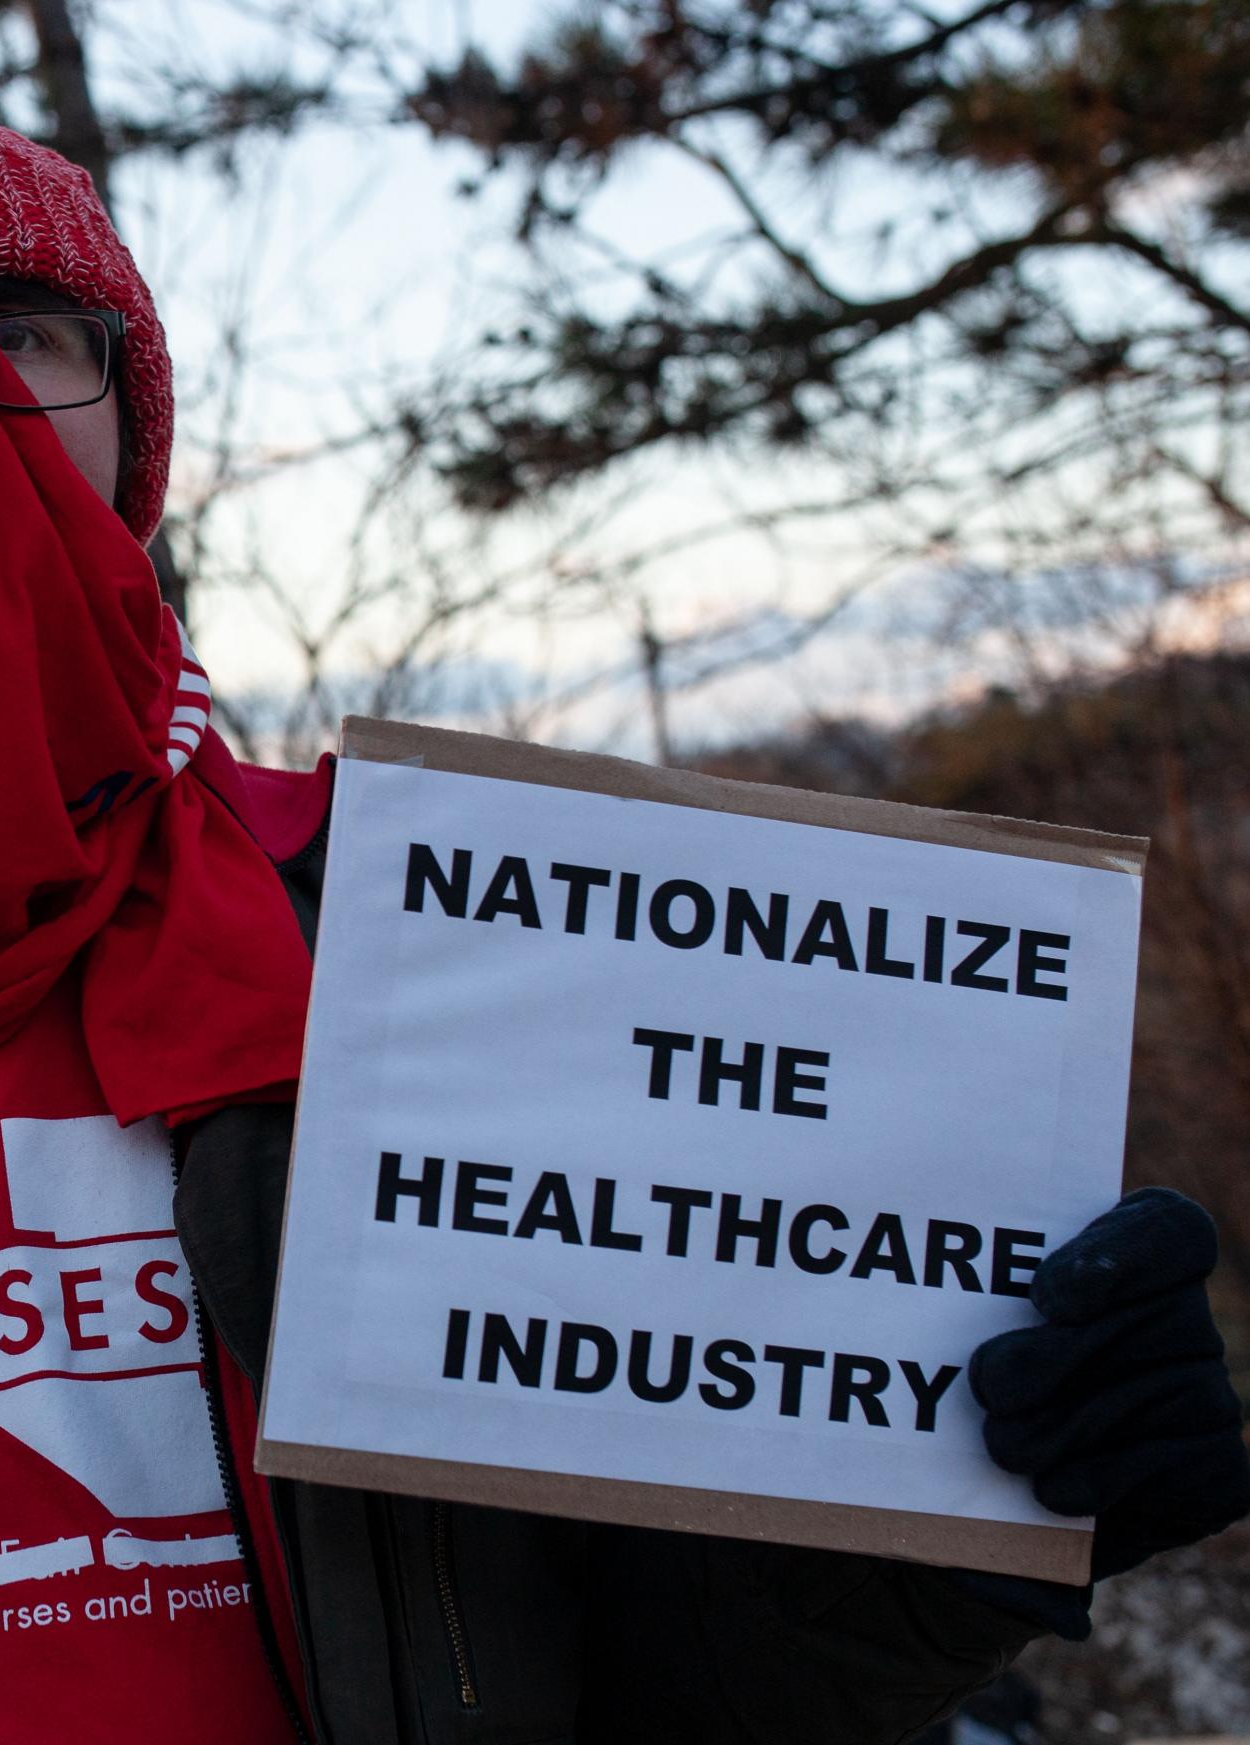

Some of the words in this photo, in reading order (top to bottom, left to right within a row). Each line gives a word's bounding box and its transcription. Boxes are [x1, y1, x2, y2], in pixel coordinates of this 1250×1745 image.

[404, 843, 1071, 1001] NATIONALIZE
[633, 1027, 831, 1120] THE
[374, 1151, 1047, 1300] HEALTHCARE
[442, 1308, 961, 1433] INDUSTRY
[85, 1578, 152, 1621] and
